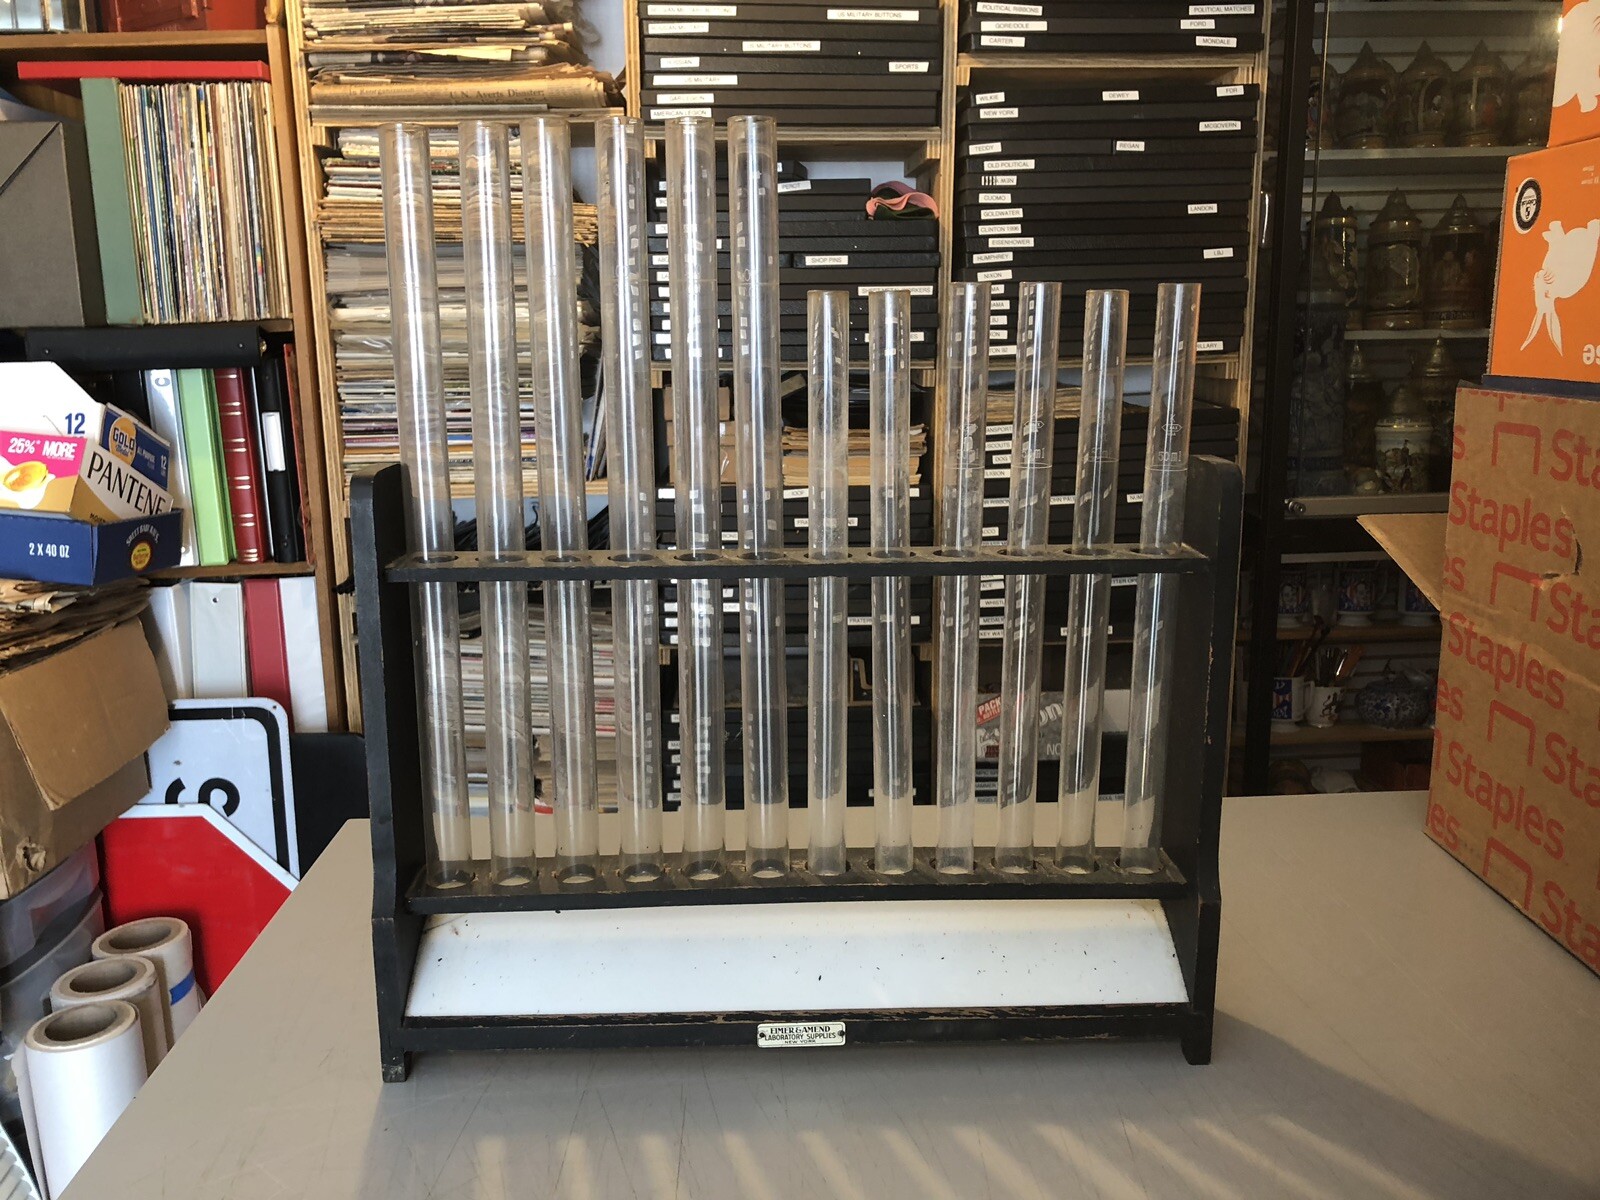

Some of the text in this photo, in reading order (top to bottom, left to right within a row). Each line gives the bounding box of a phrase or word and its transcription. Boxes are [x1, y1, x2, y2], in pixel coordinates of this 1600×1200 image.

[65, 412, 85, 434] 12
[112, 427, 135, 450] GOLD
[42, 440, 78, 458] MORE
[87, 451, 166, 516] PANTENE
[1449, 480, 1573, 558] Staples
[29, 542, 70, 558] 2 X 40 OZ
[1448, 611, 1567, 710] Staples
[1446, 740, 1565, 861] Staples
